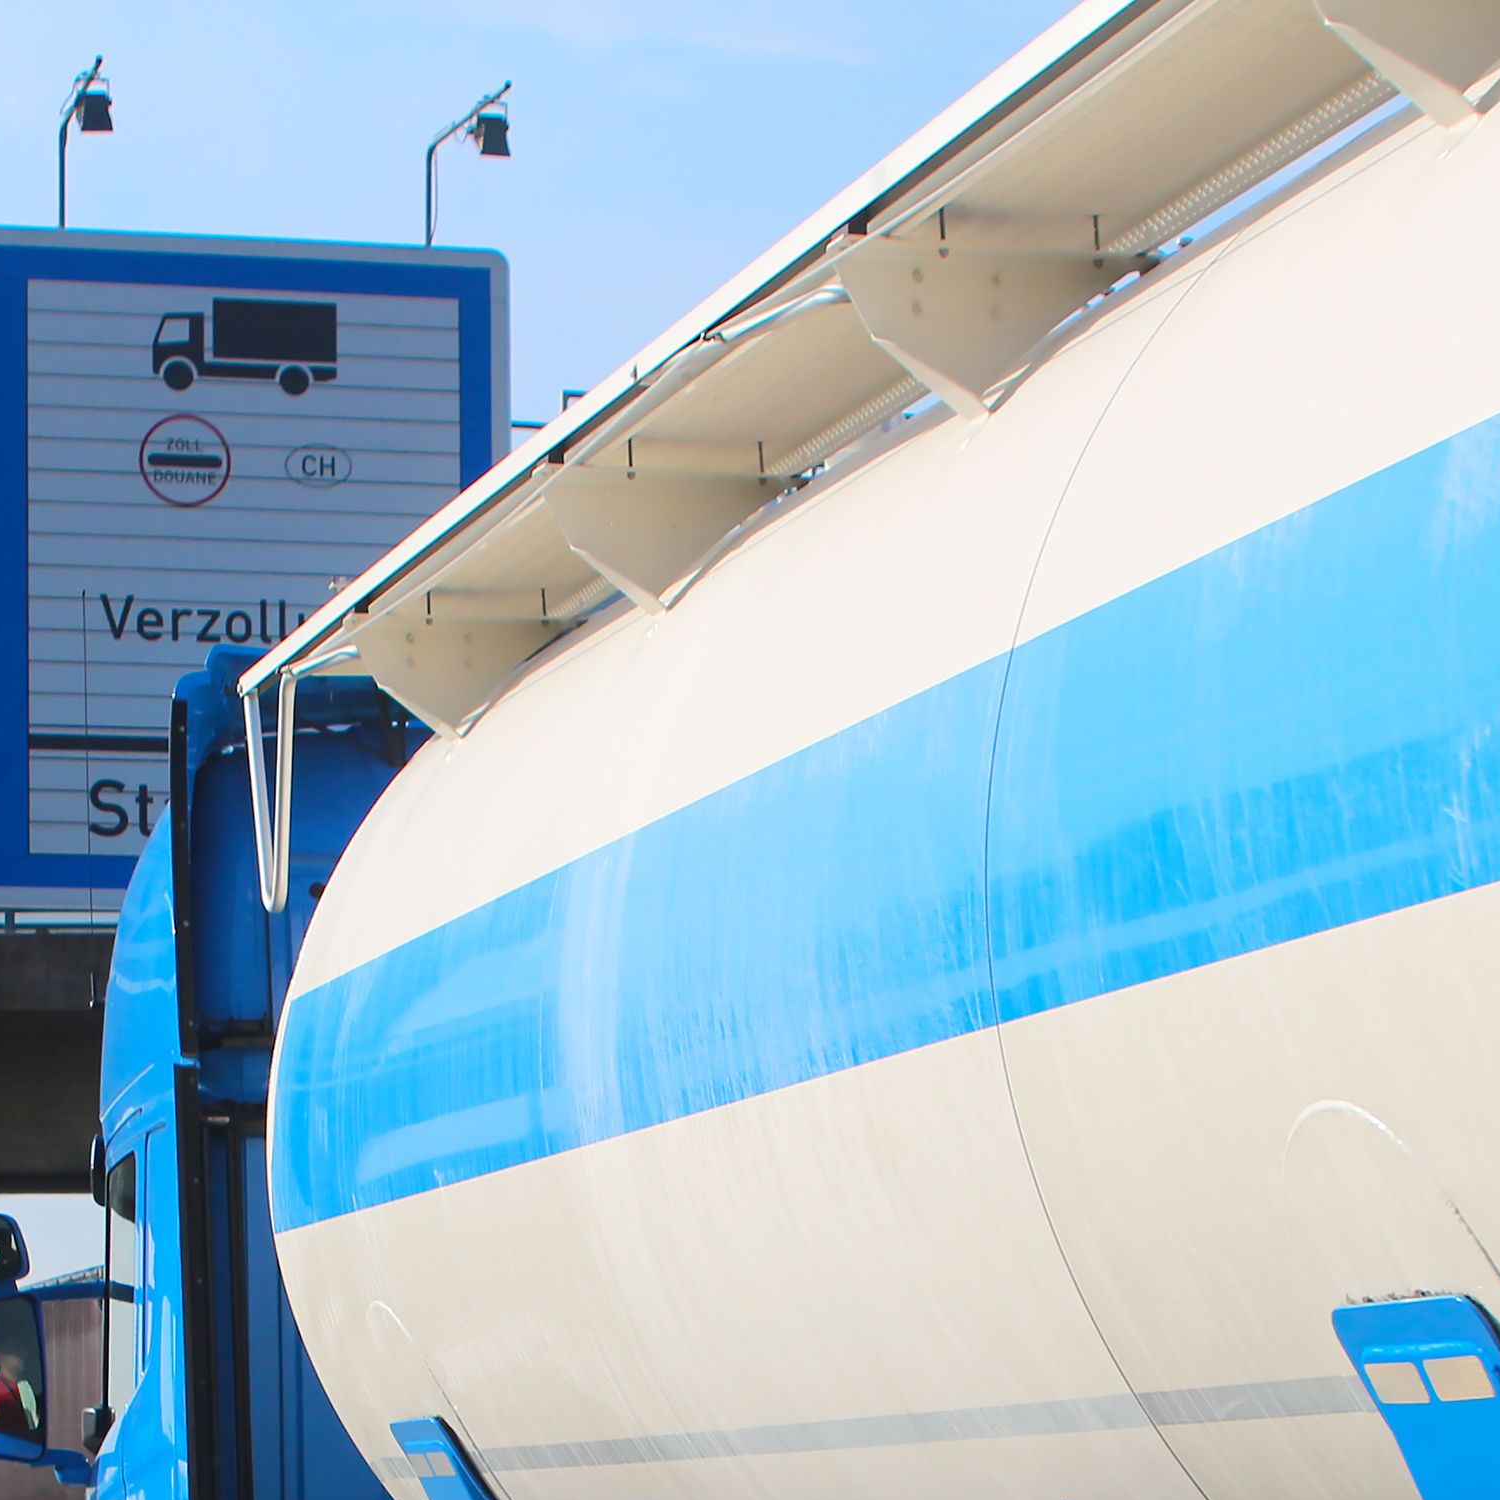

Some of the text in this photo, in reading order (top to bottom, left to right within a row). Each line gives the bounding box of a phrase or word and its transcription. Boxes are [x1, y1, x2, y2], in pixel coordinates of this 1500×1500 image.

[153, 470, 217, 486] DOUANE
[301, 455, 336, 478] CH
[100, 593, 305, 643] Verzoll
[89, 778, 170, 838] St
